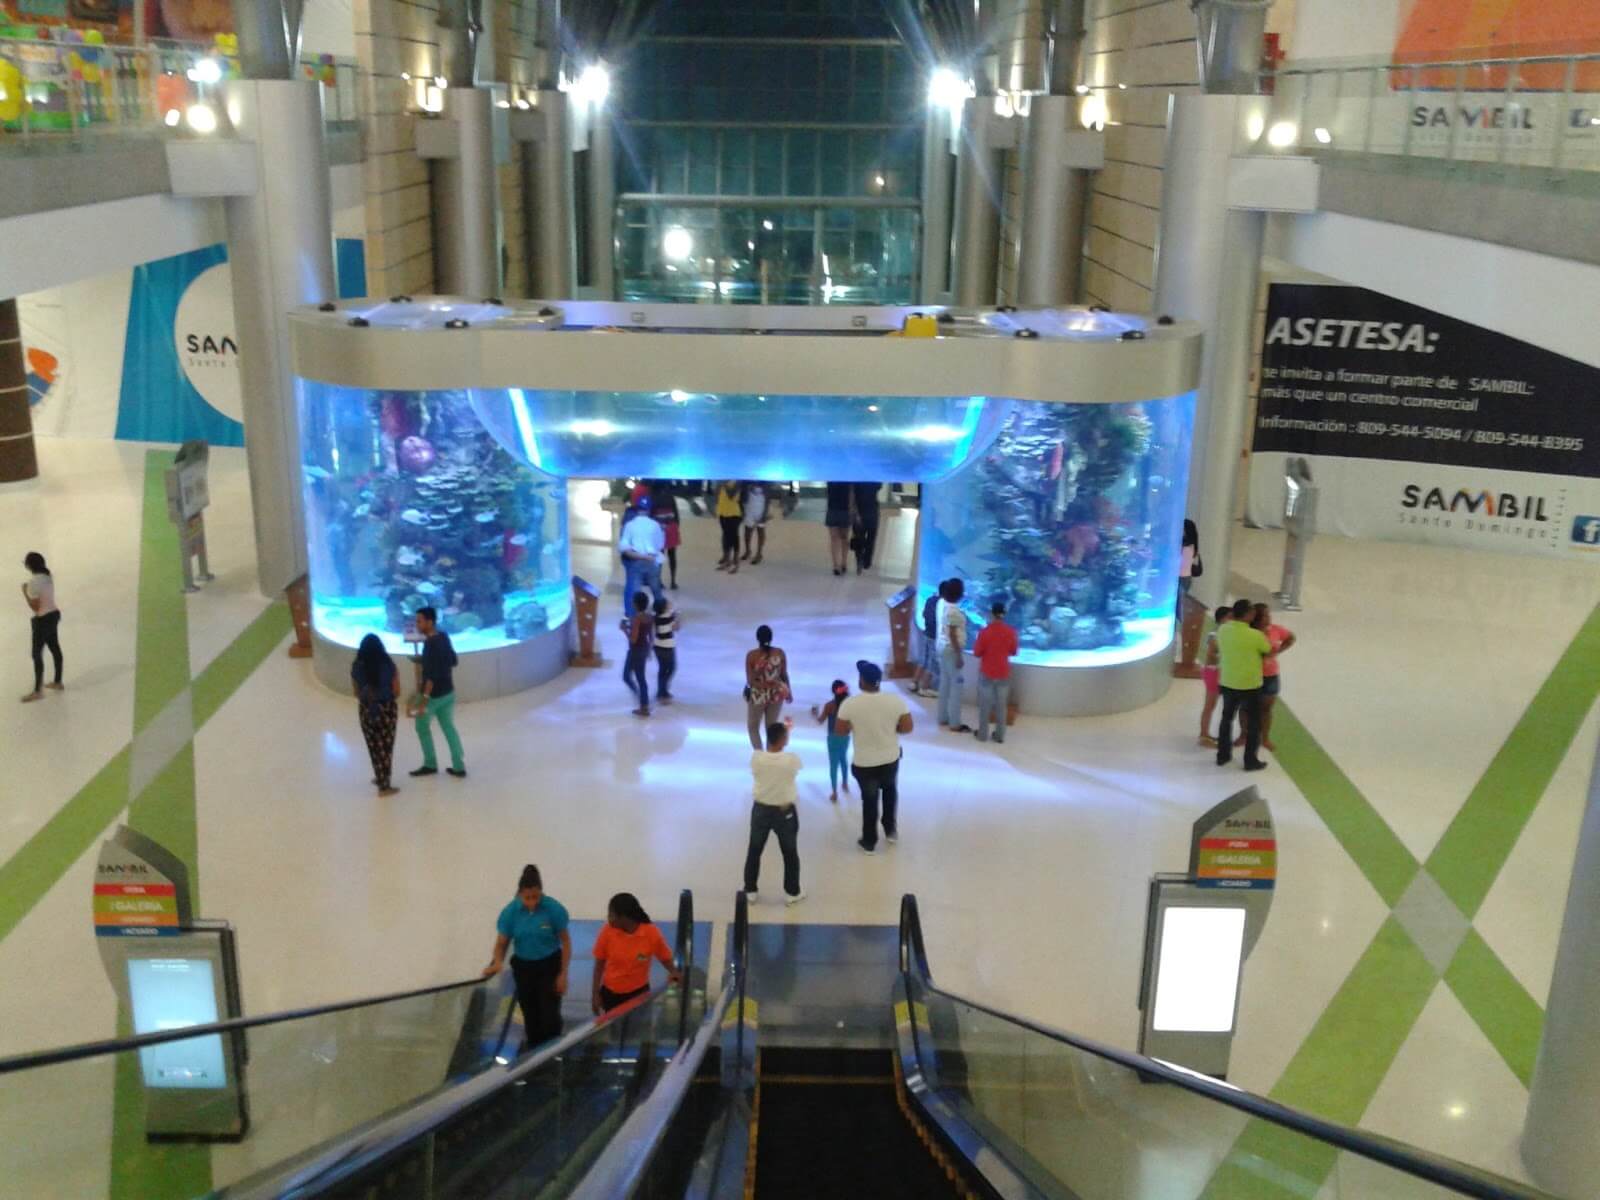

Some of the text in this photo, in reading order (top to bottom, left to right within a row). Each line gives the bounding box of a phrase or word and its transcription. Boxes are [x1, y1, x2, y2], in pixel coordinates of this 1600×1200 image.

[1265, 316, 1440, 354] ASETESA:
[1324, 370, 1335, 382] a
[1336, 367, 1389, 385] formar
[1390, 374, 1434, 389] parte
[1435, 375, 1459, 390] de
[1293, 388, 1325, 402] que
[1325, 391, 1347, 402] un
[1348, 392, 1399, 406] centro
[1401, 396, 1479, 412] comercial
[1401, 484, 1549, 522] SAMBIL
